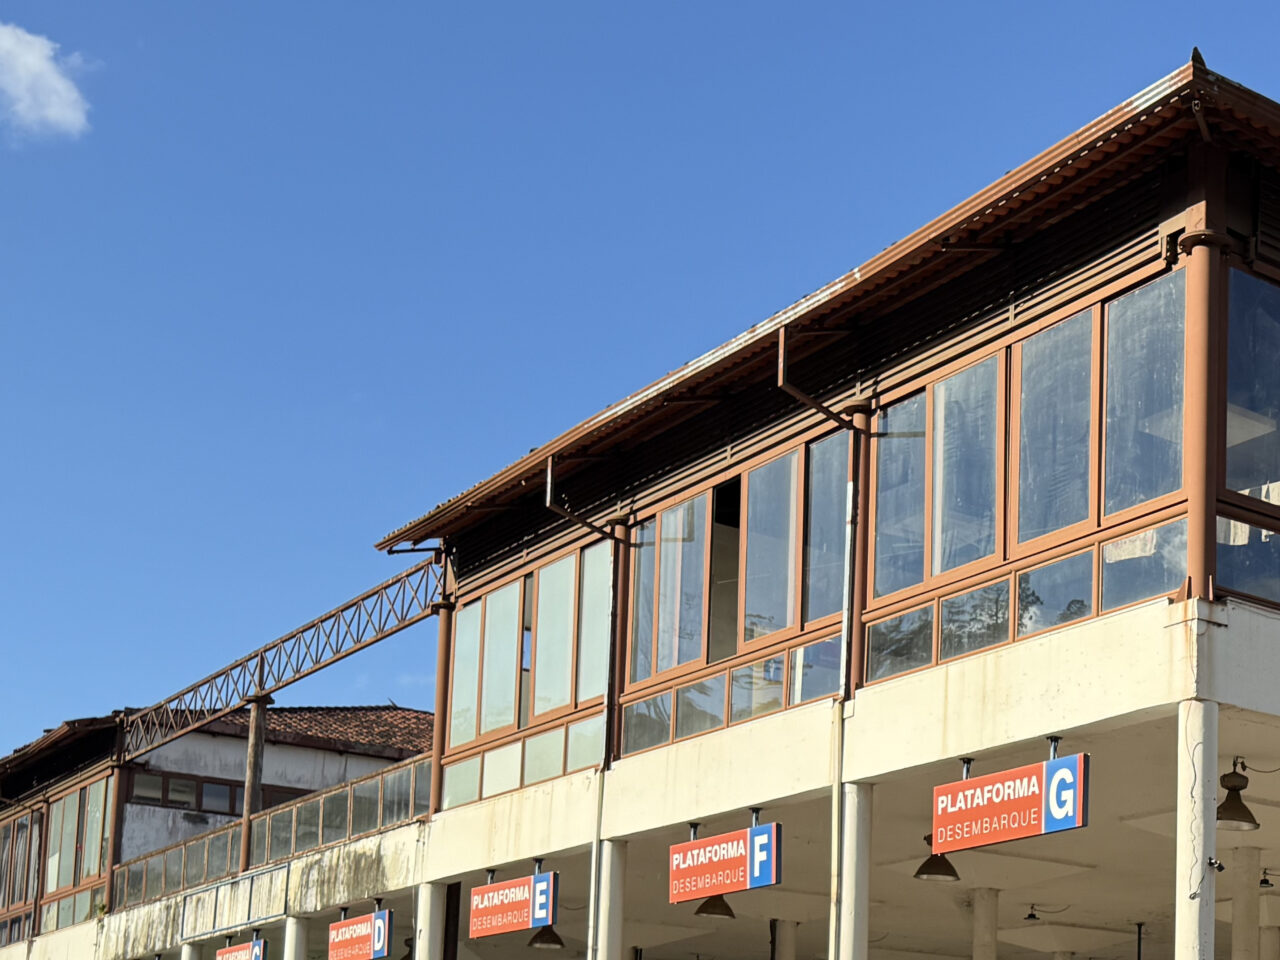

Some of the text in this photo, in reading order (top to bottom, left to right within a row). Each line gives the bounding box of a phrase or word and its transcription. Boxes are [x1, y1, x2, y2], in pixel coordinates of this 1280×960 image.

[937, 774, 1040, 816] PLATAFORMA
[1049, 767, 1075, 820] G
[937, 807, 1039, 843] DESEMBARQUE
[672, 839, 746, 871] PLATAFORMA
[754, 833, 769, 878] F
[672, 866, 745, 894] DESEMBARQUE
[472, 884, 530, 911] PLATAFORMA
[534, 881, 548, 919] E
[330, 920, 371, 943] PLATAFORMA
[374, 918, 385, 951] D
[472, 908, 529, 931] DESEMBARQUE
